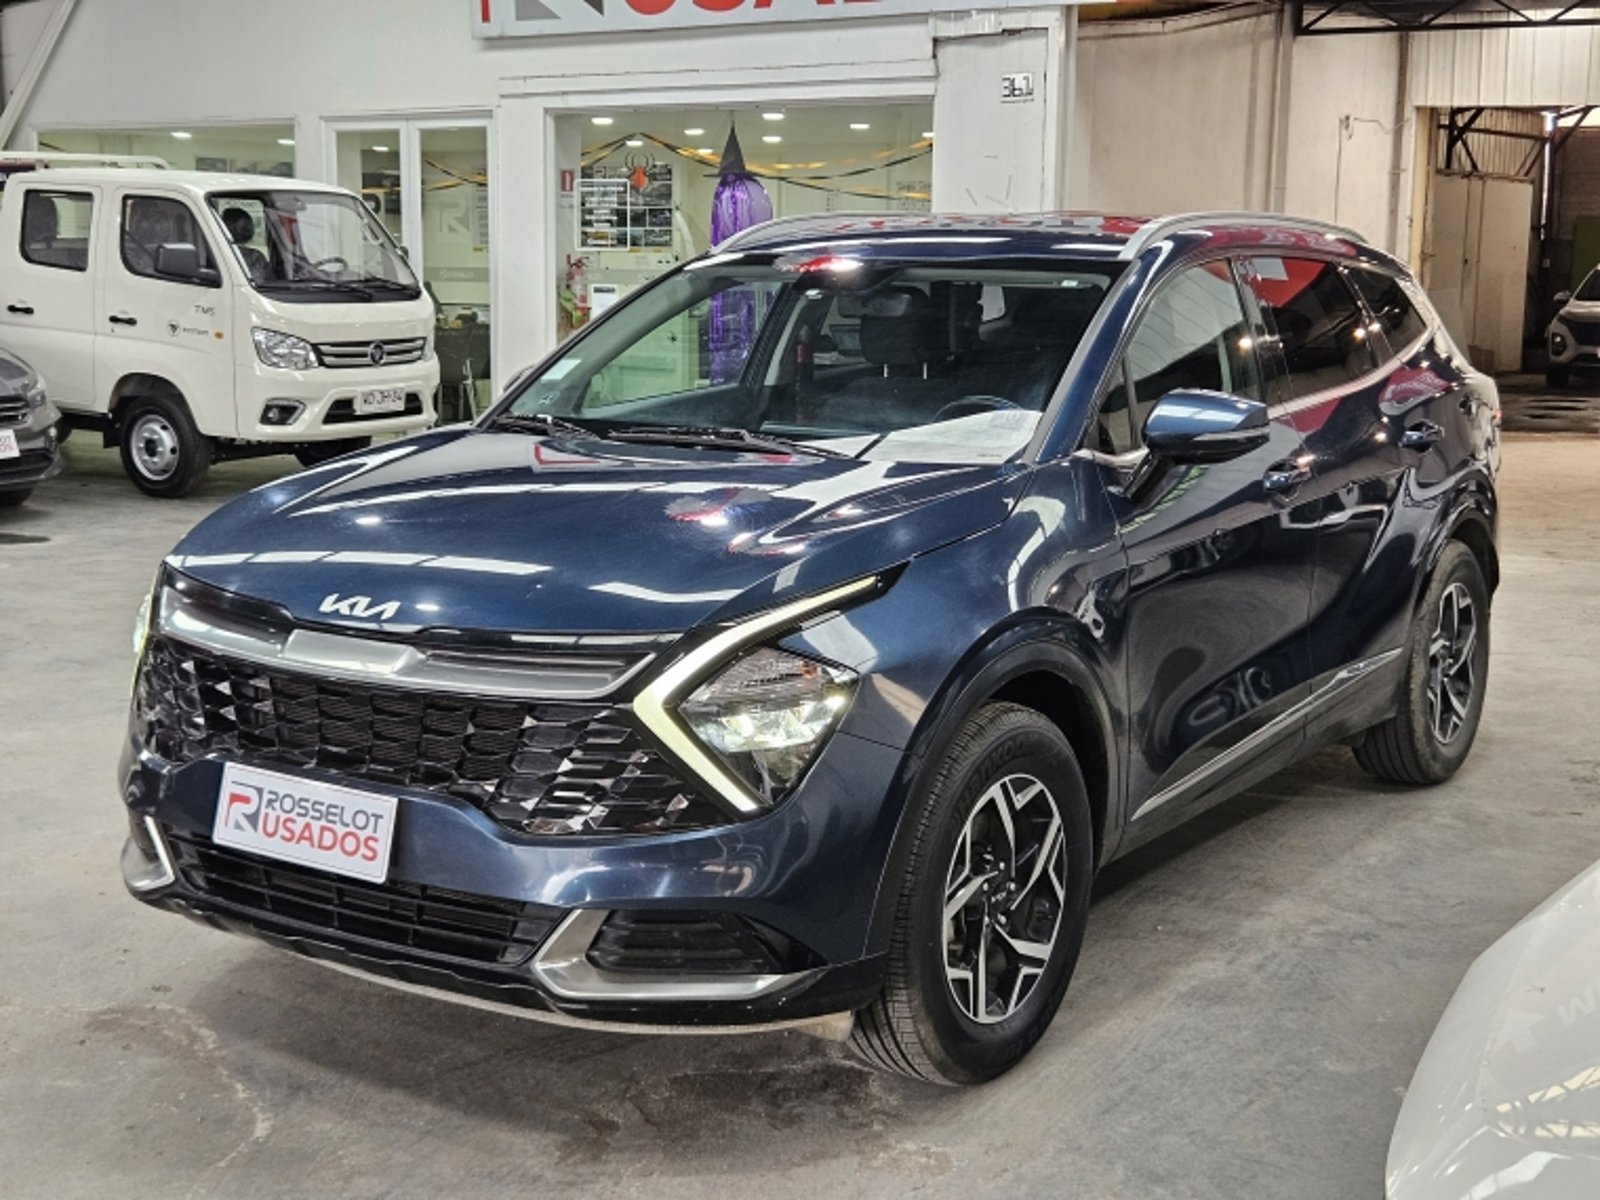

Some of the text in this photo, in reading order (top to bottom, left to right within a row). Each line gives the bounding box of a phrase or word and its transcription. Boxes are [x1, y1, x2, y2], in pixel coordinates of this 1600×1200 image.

[318, 593, 402, 620] KIA
[264, 790, 384, 834] ROSSELOT
[262, 812, 380, 862] USADOS
